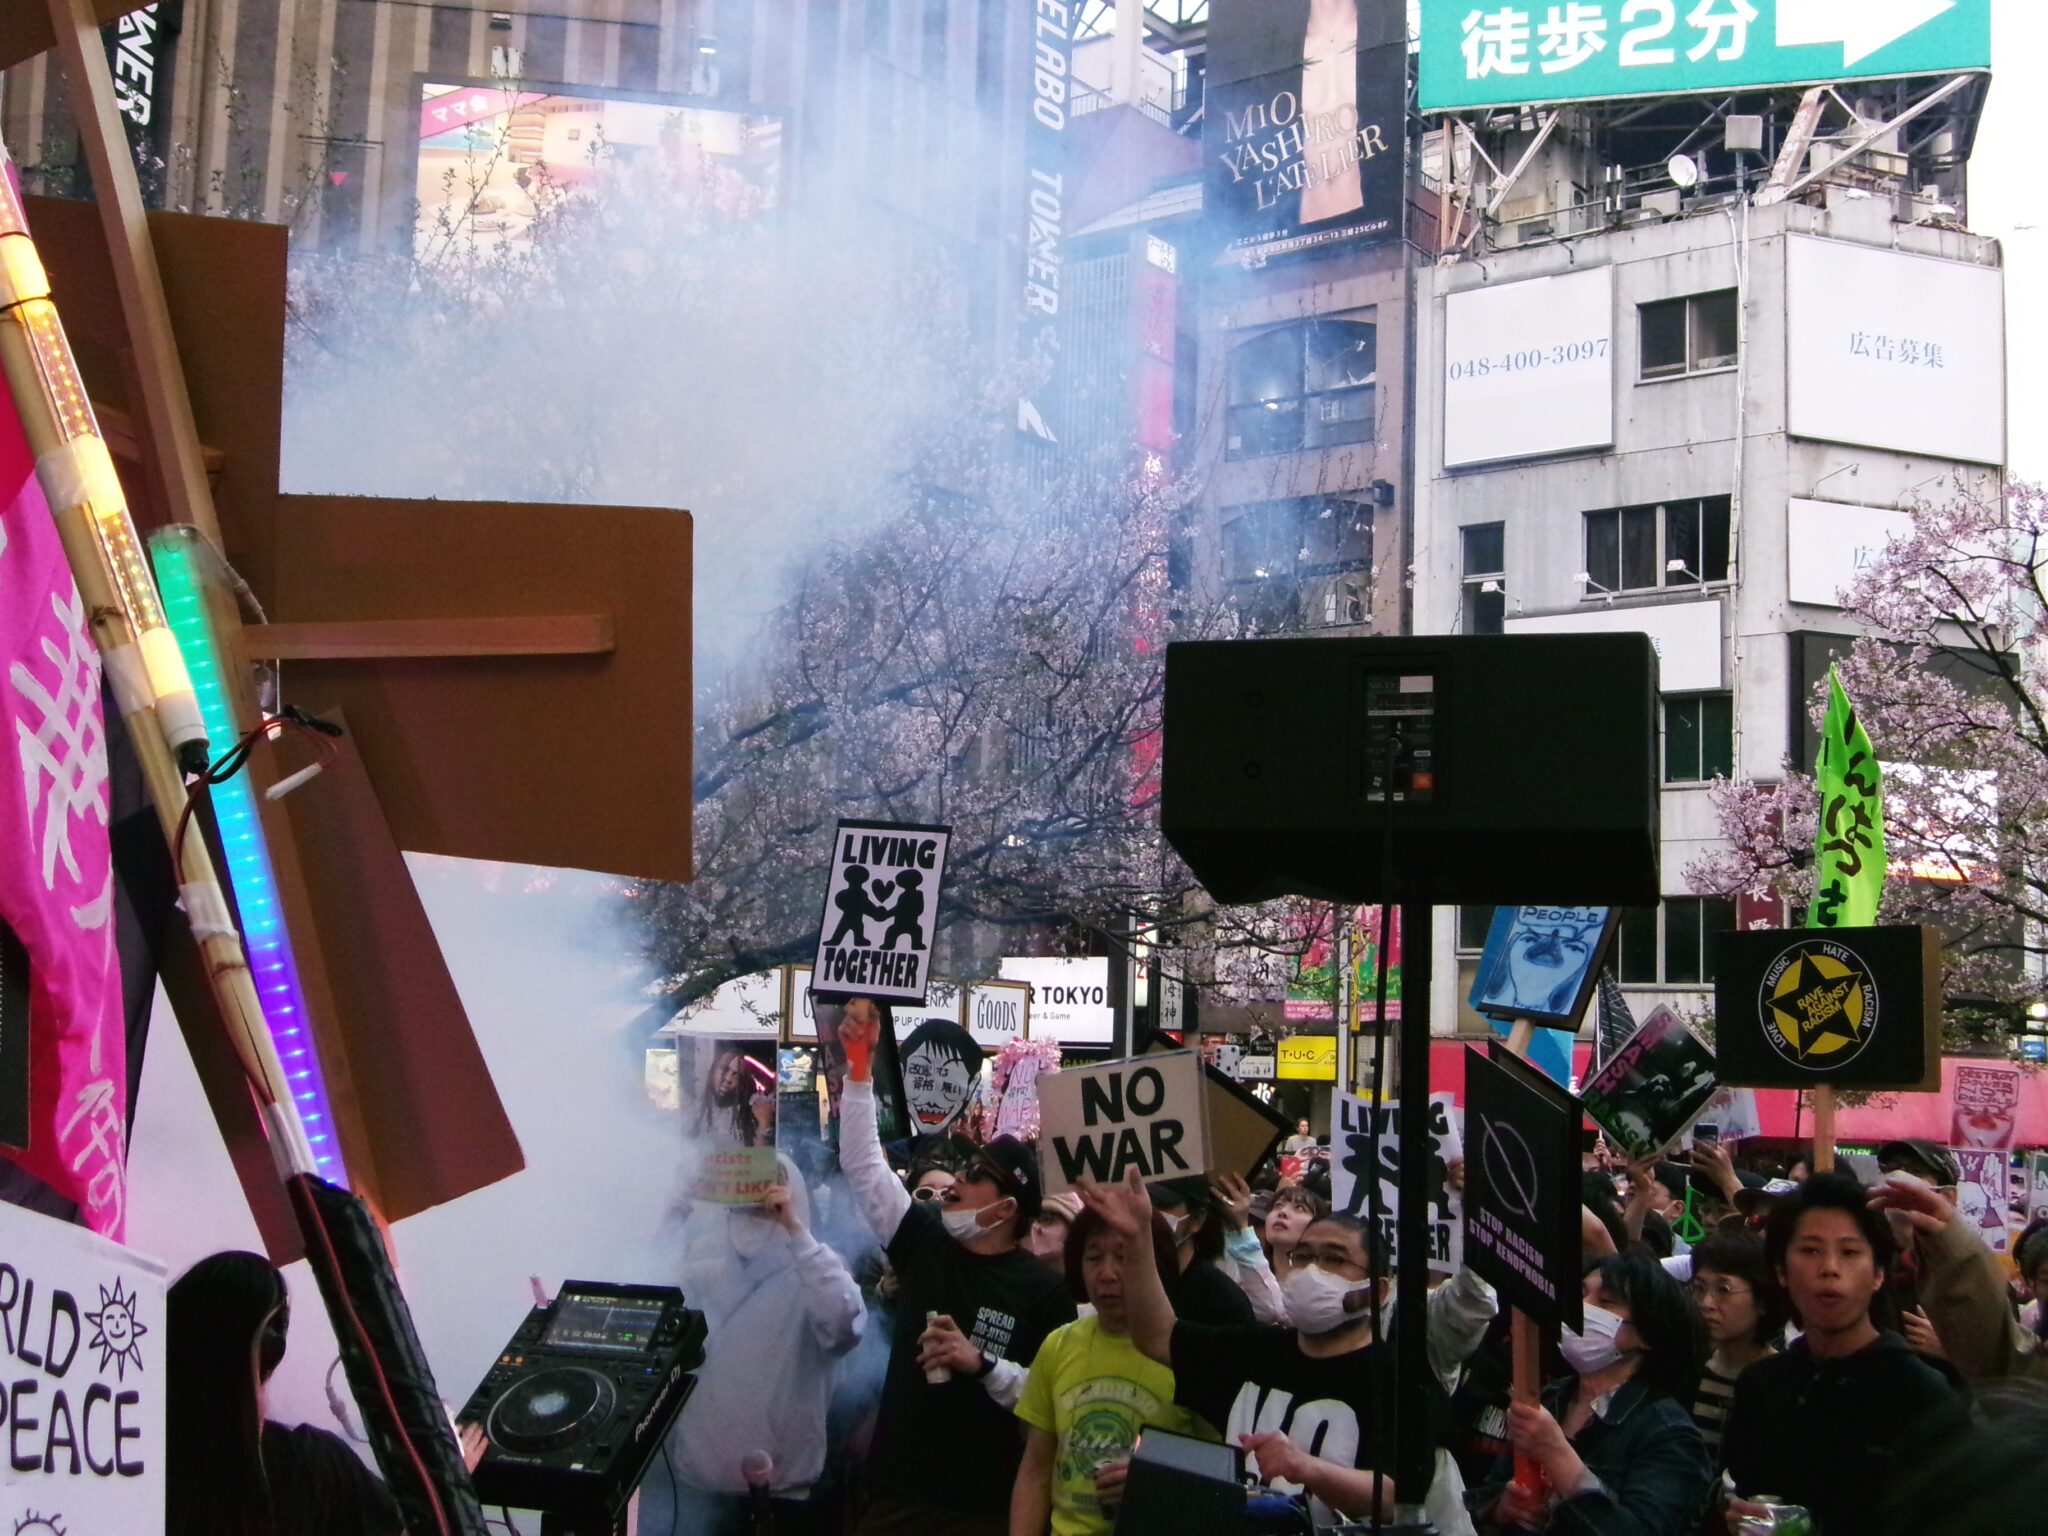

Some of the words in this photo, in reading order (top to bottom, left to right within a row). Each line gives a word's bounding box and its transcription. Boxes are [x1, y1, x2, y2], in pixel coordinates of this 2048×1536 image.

[1460, 0, 1760, 80] 徒歩2分
[114, 3, 158, 125] WER
[1225, 91, 1296, 143] MIO
[1219, 102, 1359, 183] YASHIRO
[1449, 338, 1609, 380] 048-400-3097
[1849, 331, 1943, 368] 広告募集
[842, 834, 938, 870] LIVING
[1522, 907, 1599, 923] PEOPLE
[823, 947, 919, 989] TOGETHER
[1822, 943, 1849, 963] HATE
[1766, 956, 1790, 987] MUSIC
[1042, 986, 1103, 1004] TOKYO
[1797, 985, 1825, 1011] RAVE
[1806, 981, 1850, 1016] AGAINST
[1861, 984, 1873, 1027] RACISM
[901, 1016, 913, 1026] UP
[977, 1000, 1017, 1031] GOODS
[1050, 1012, 1071, 1020] Game
[1801, 1001, 1843, 1032] RACISM
[1766, 1022, 1787, 1049] LOVE
[1957, 1087, 2013, 1097] NOT
[1958, 1069, 2015, 1082] DESTROY
[1081, 1066, 1165, 1127] NO
[1051, 1119, 1190, 1185] WAR
[1480, 1206, 1503, 1234] STOP
[1505, 1226, 1544, 1270] RACISM
[1469, 1217, 1493, 1247] STOP
[1496, 1239, 1556, 1301] XENOPHOBIA
[973, 1319, 1011, 1345] JIU-JITSU
[977, 1307, 1015, 1330] SPREAD
